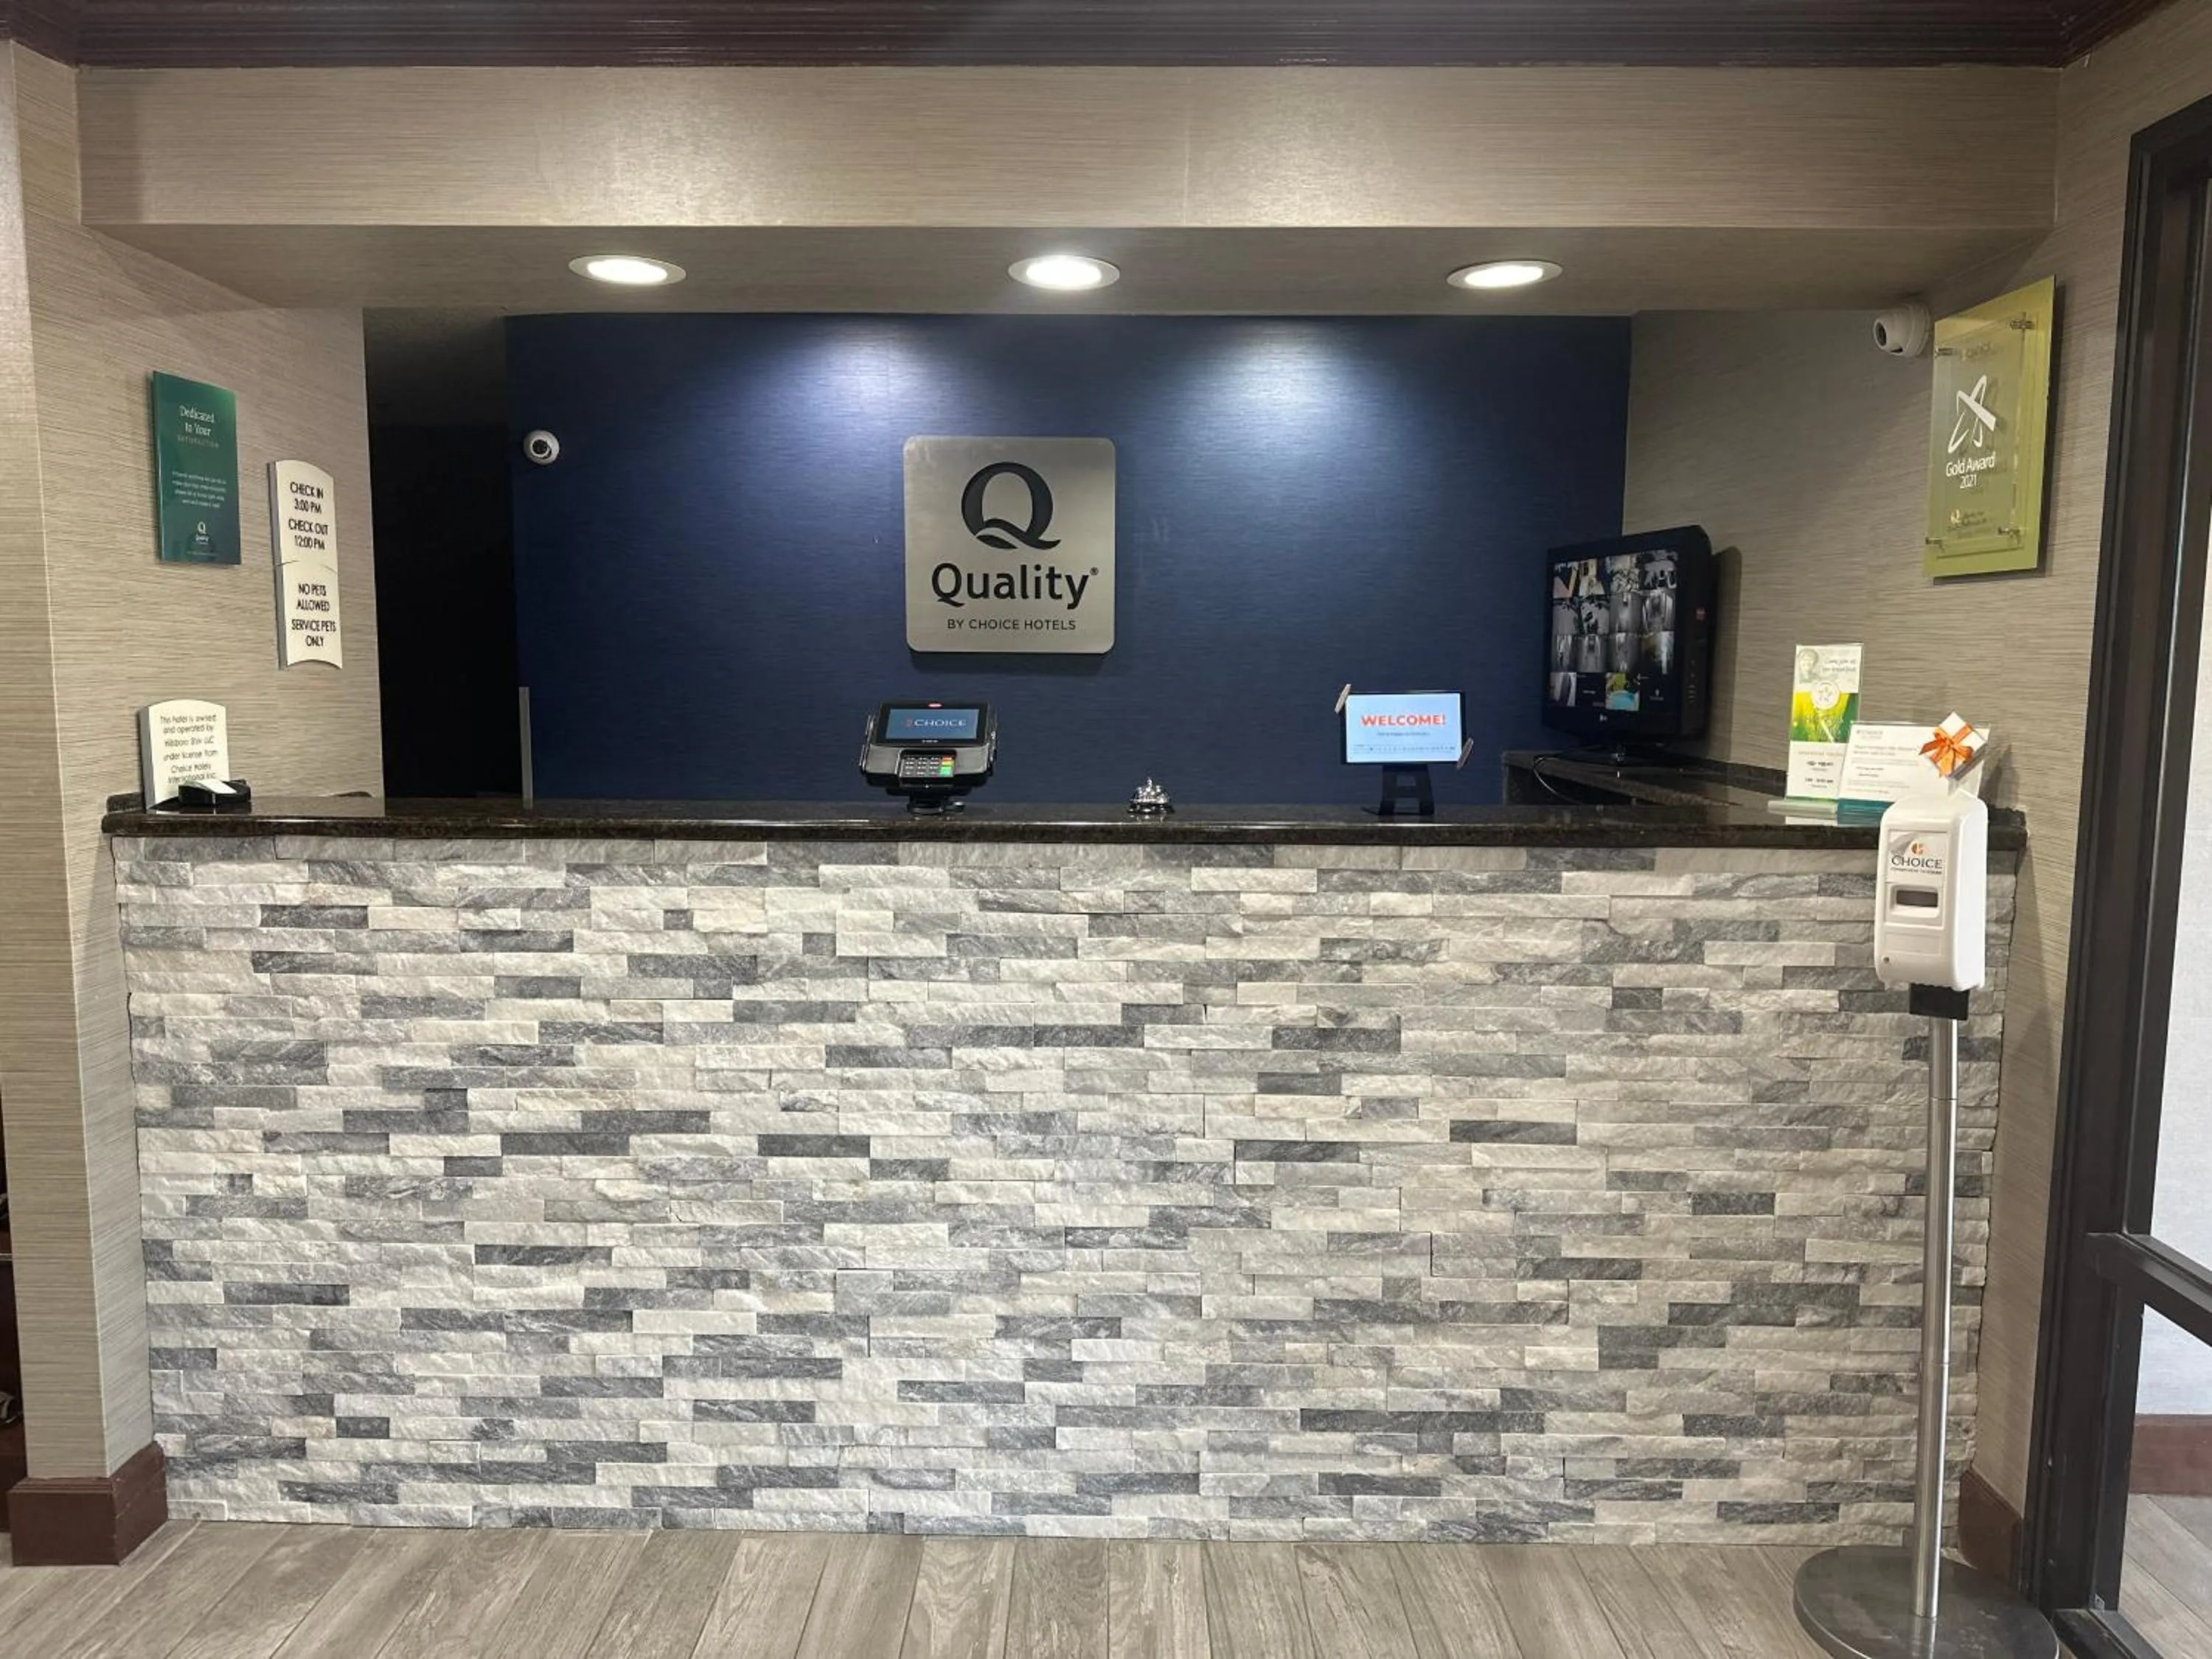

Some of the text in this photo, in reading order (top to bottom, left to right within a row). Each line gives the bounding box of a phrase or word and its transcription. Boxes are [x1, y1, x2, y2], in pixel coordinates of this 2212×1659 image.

[1946, 451, 1996, 477] Gold Award
[290, 481, 324, 499] CHECK IN
[310, 501, 322, 515] PM
[288, 518, 329, 536] CHECK OUT
[314, 538, 325, 551] PM
[298, 583, 327, 597] NO PETS
[296, 599, 330, 612] ALLOWED
[291, 619, 337, 633] SERVICE PETS
[947, 619, 1076, 631] BY CHOICE HOTELS
[305, 635, 324, 647] ONLY
[914, 719, 967, 727] CHOICE
[1361, 713, 1447, 726] WELCOME!
[1891, 855, 1942, 869] CHOICE
